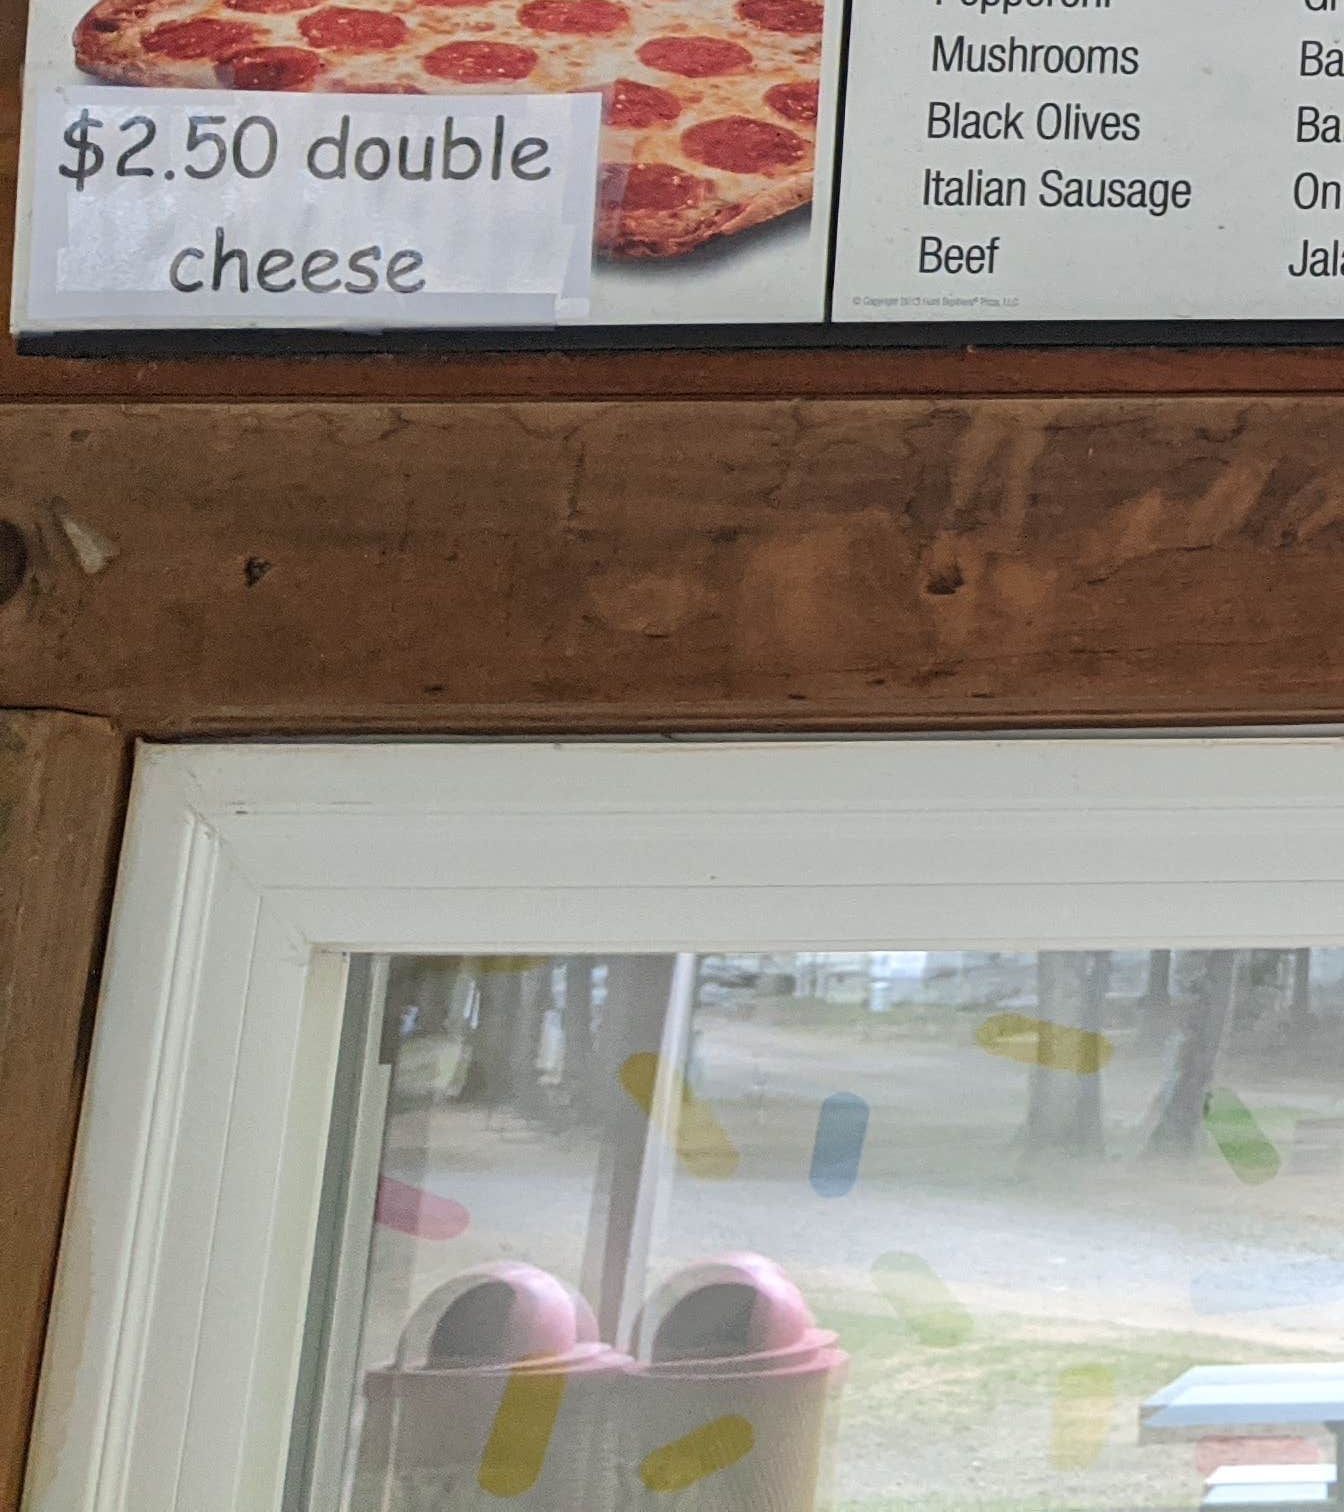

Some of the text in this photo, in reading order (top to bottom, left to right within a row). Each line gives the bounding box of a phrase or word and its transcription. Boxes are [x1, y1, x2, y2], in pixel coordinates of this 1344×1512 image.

[933, 36, 1138, 74] Mushrooms
[928, 102, 1140, 140] Black Olives
[59, 109, 550, 192] $2.50 double
[924, 169, 1191, 216] Italian Sausage
[170, 227, 425, 294] cheese
[919, 236, 1000, 274] Beef
